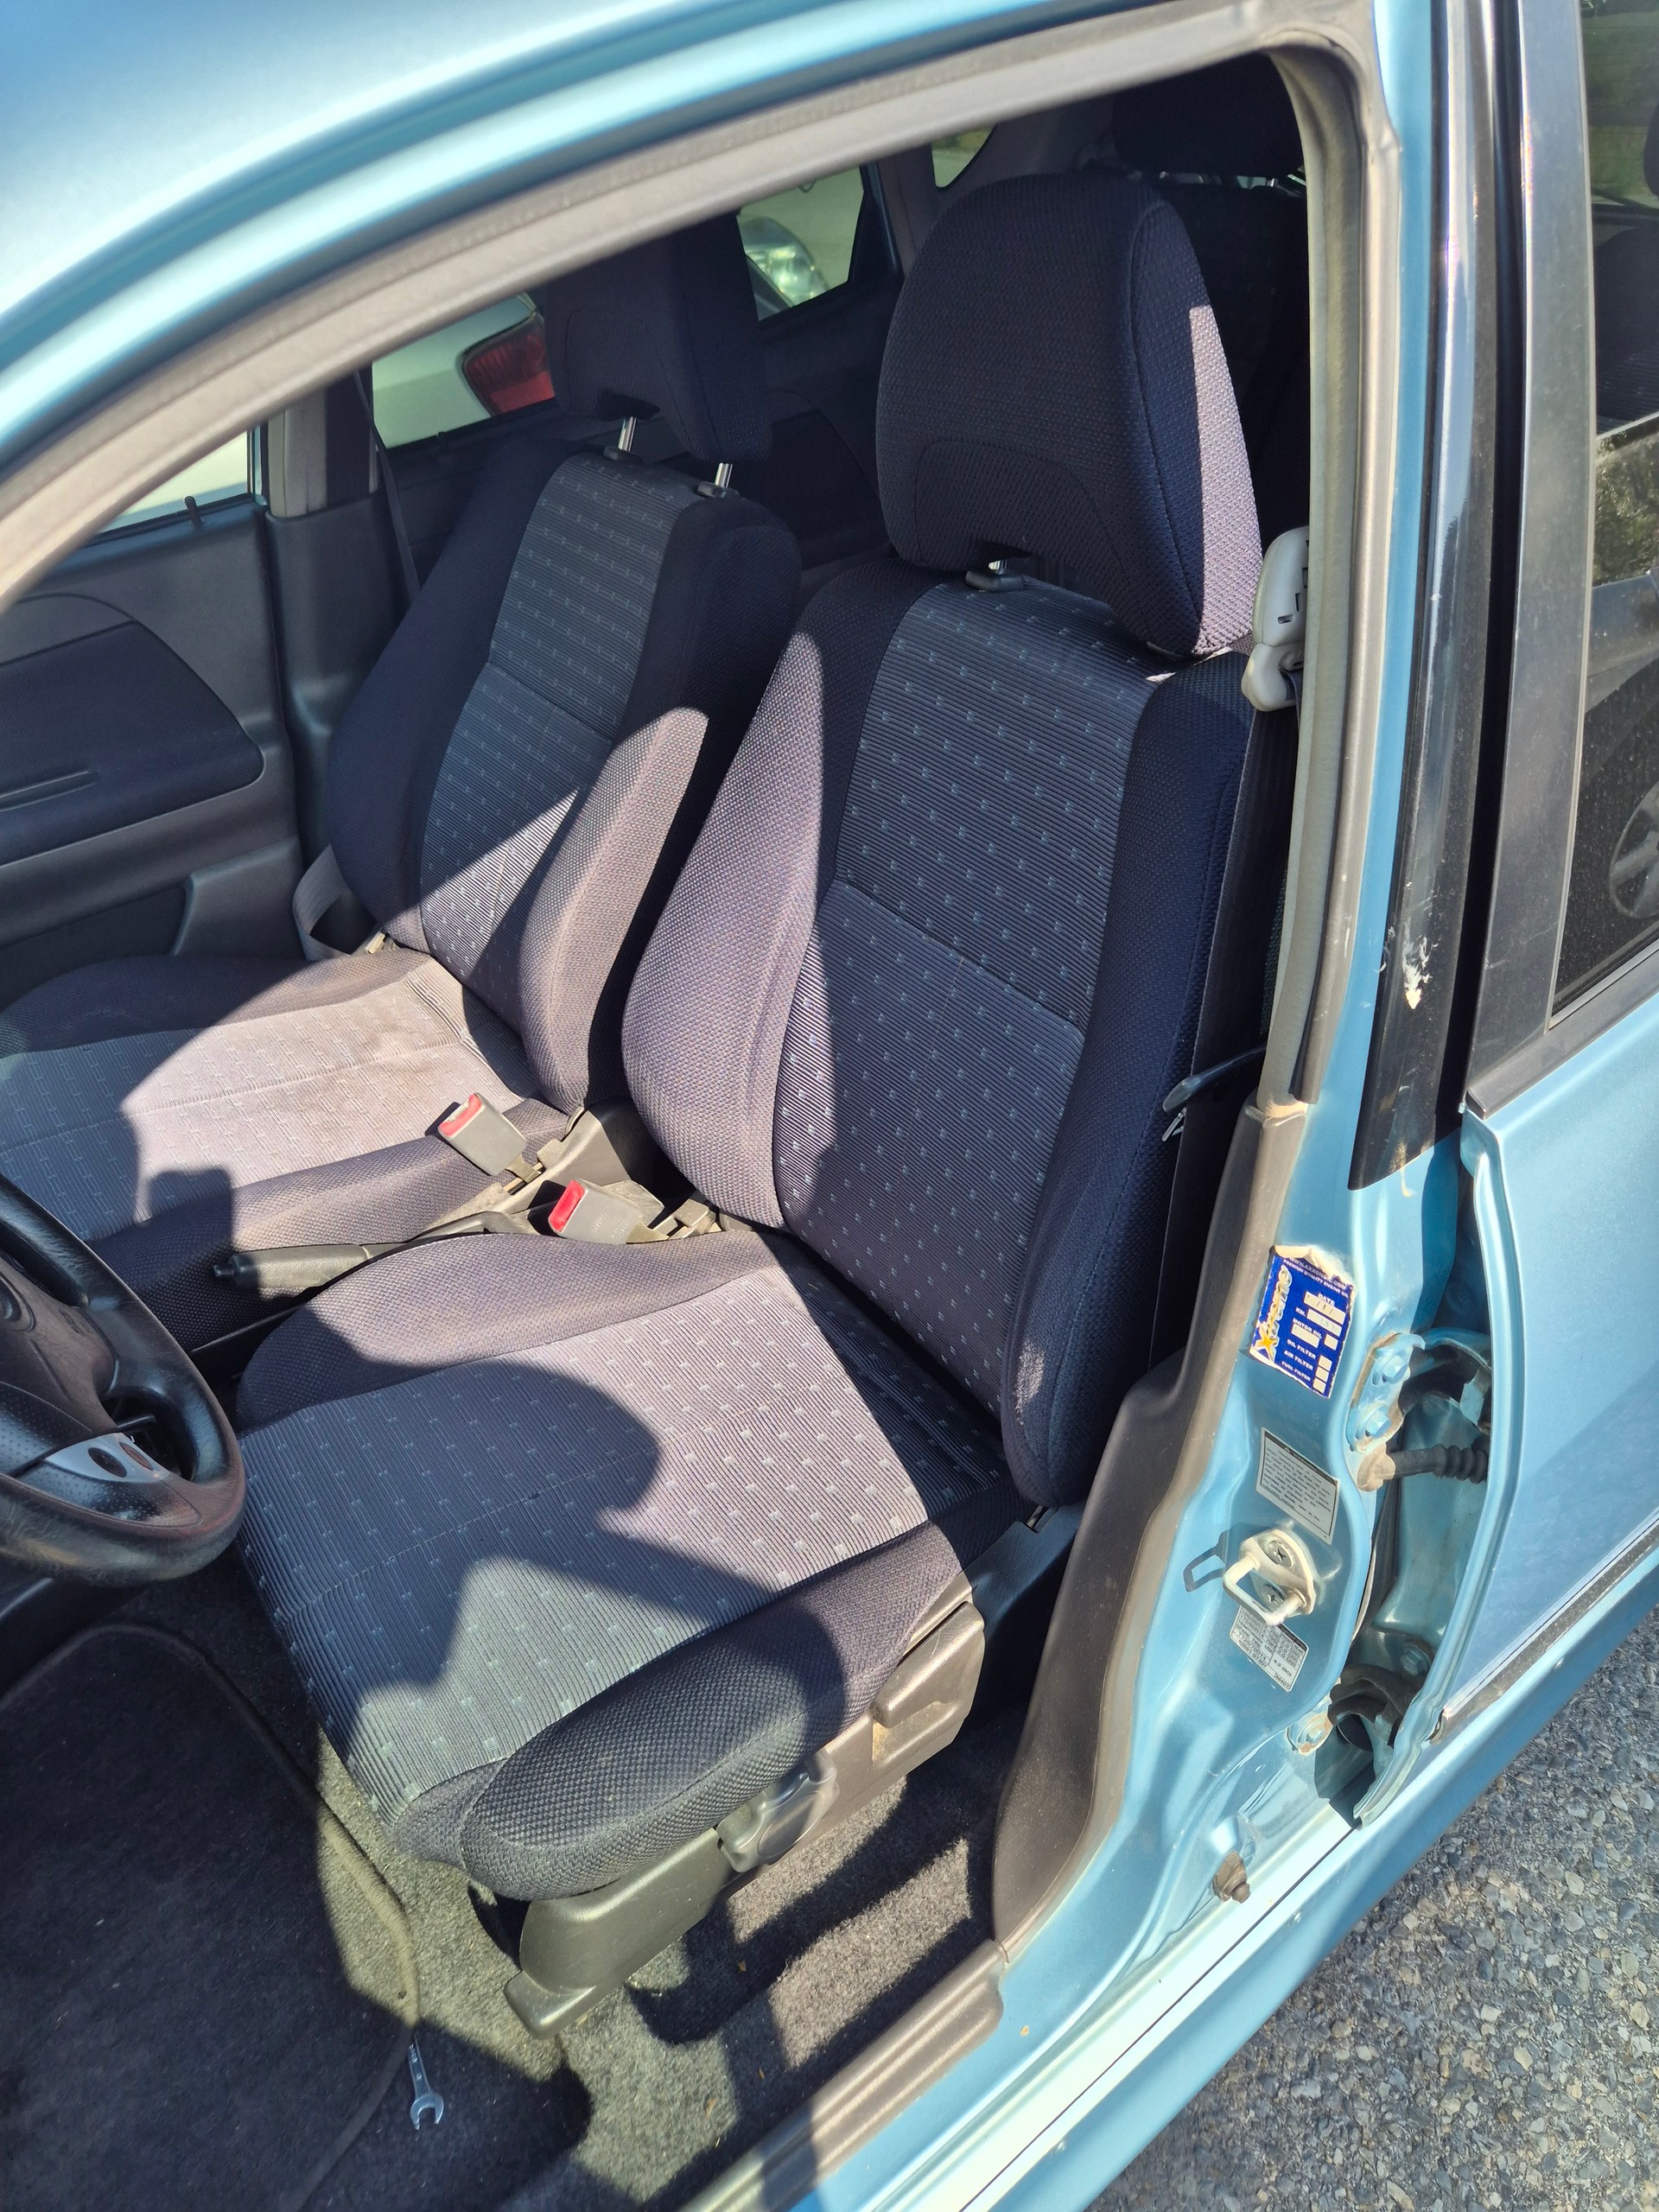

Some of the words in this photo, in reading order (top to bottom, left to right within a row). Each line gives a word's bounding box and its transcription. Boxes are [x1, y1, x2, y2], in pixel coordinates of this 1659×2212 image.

[1282, 1258, 1304, 1273] PREMIUM
[1304, 1269, 1323, 1284] QUALITY
[1323, 1281, 1340, 1294] ENGINE
[1317, 1293, 1335, 1306] DATE
[1255, 1264, 1293, 1363] Xtreme
[1292, 1317, 1312, 1332] MOTOR
[1313, 1329, 1322, 1338] OIL
[1287, 1338, 1296, 1348] OIL
[1297, 1344, 1316, 1359] FILTER
[1283, 1350, 1293, 1358] AIR
[1294, 1356, 1313, 1370] FILTER
[1281, 1360, 1293, 1370] FUEL
[1294, 1368, 1311, 1382] FILTER
